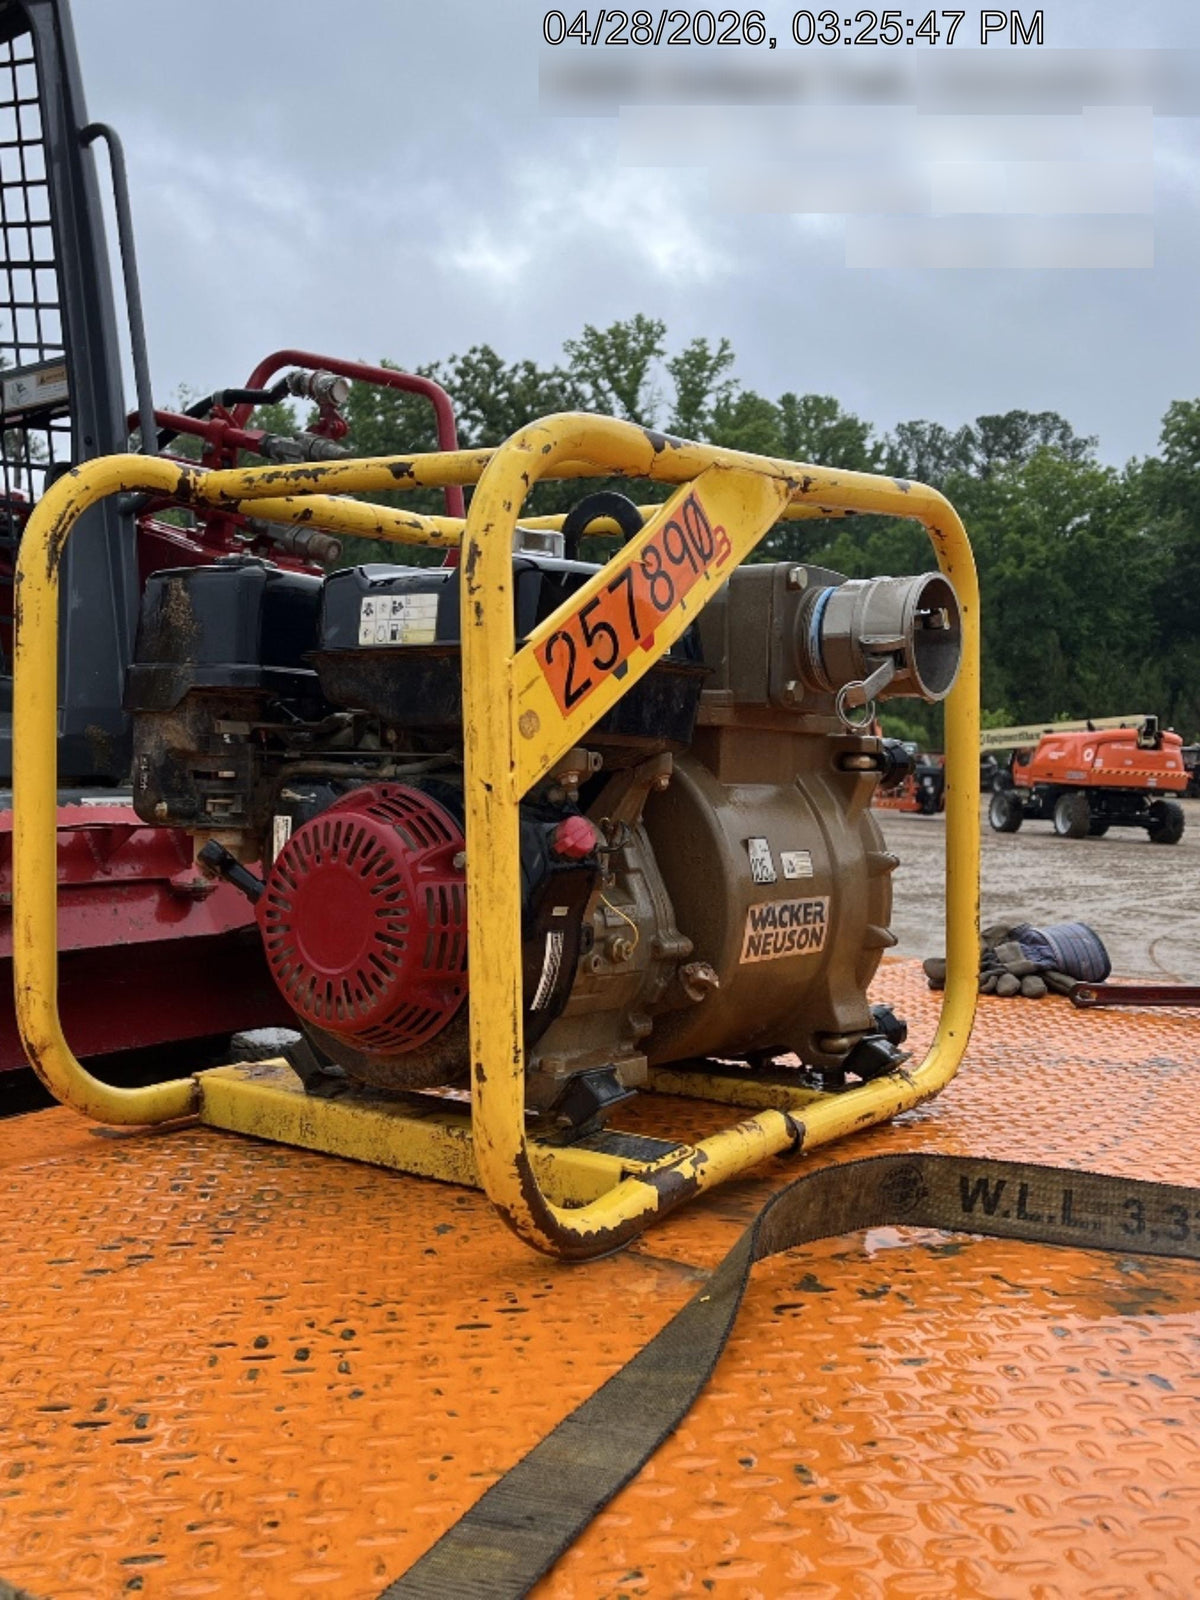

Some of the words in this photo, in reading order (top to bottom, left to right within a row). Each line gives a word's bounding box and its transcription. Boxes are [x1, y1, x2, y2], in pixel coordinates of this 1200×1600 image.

[545, 493, 714, 709] 257890
[750, 901, 826, 931] WACKER
[745, 926, 824, 959] NEUSON
[1121, 1197, 1200, 1244] 3,3
